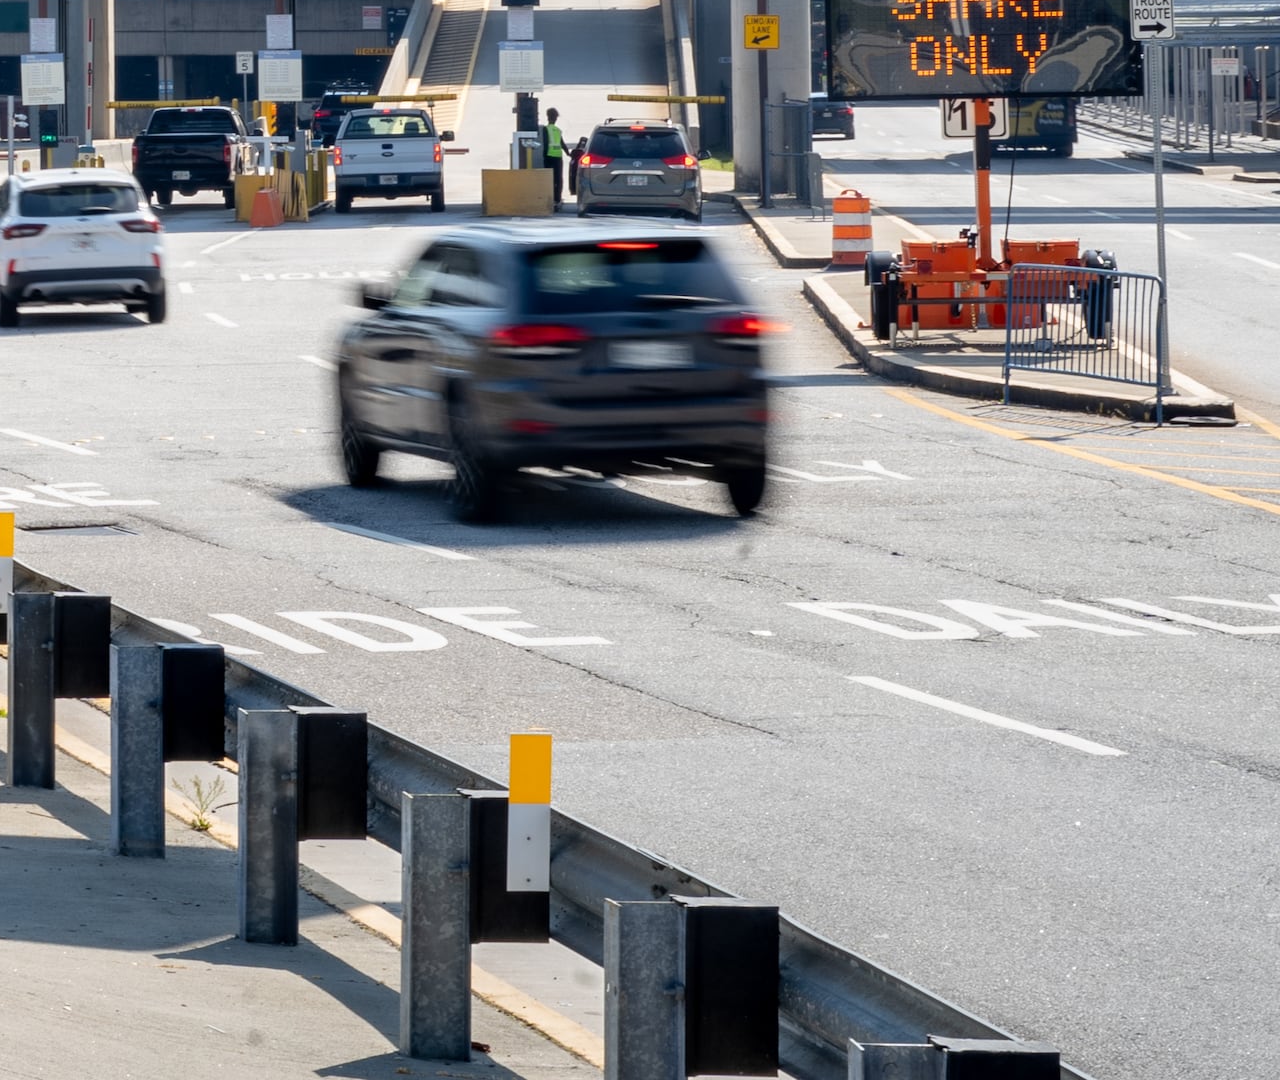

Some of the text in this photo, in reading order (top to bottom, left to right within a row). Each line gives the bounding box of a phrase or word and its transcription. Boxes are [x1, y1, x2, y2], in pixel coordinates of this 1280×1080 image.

[1134, 7, 1171, 20] ROUTE
[752, 25, 771, 34] LANE
[909, 33, 1047, 77] ONLY
[241, 62, 249, 71] 5
